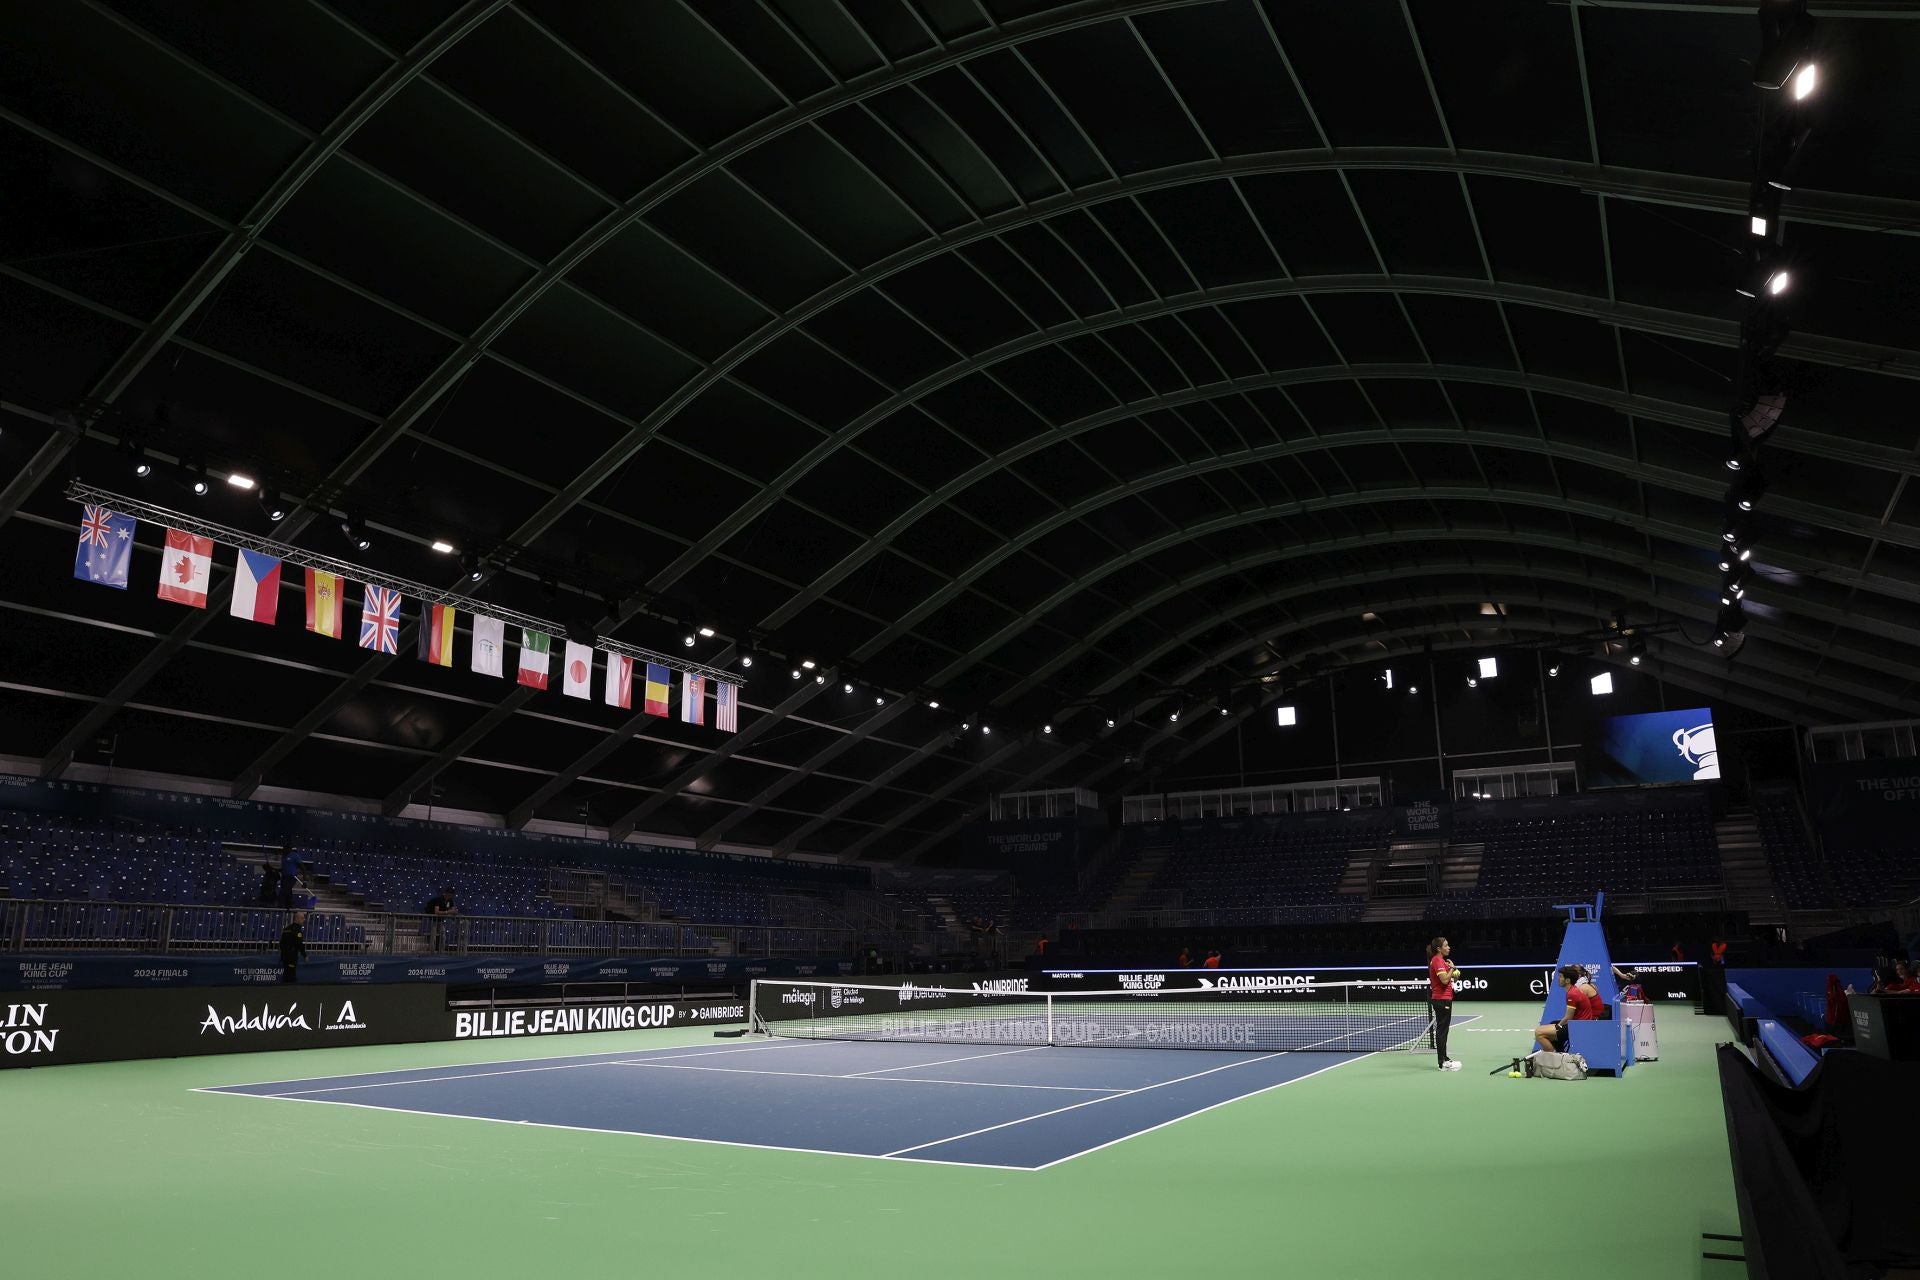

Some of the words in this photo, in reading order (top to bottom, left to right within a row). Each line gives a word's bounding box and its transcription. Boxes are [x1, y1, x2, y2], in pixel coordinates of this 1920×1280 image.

[1856, 778, 1889, 791] THE
[1883, 789, 1905, 800] OF
[1908, 788, 1920, 800] T
[1406, 807, 1439, 816] WORLD
[1408, 815, 1426, 823] CUP
[1427, 814, 1439, 822] OF
[1408, 822, 1440, 831] TENNIS
[987, 834, 1006, 844] THE
[1007, 833, 1041, 843] WORLD
[1043, 832, 1062, 842] CUP
[1000, 843, 1013, 853] OF
[1014, 842, 1048, 852] TENNIS
[20, 962, 47, 970] BILLIE
[48, 962, 73, 970] JEAN
[1634, 965, 1657, 973] SERVE
[23, 970, 47, 978] KING
[48, 970, 68, 978] CUP
[133, 969, 157, 977] 2024
[157, 969, 188, 977] FINALS
[1118, 974, 1142, 983] BILLIE
[1143, 974, 1165, 983] JEAN
[982, 979, 1029, 998] GAINBRIDGE
[1123, 981, 1143, 990] KING
[1144, 981, 1161, 990] CUP
[1217, 976, 1316, 994] GAINBRIDGE
[782, 987, 816, 1006] málaga
[1667, 991, 1687, 999] km/h
[0, 1004, 48, 1027] IN
[200, 1002, 312, 1035] Andalucía
[455, 1010, 525, 1038] BILLIE
[527, 1008, 583, 1034] JEAN
[587, 1006, 634, 1031] KING
[637, 1005, 674, 1027] CUP
[678, 1010, 687, 1018] BY
[700, 1006, 744, 1019] GAINBRIDGE
[991, 1020, 1049, 1041] KING
[1056, 1021, 1100, 1042] CUP
[1146, 1023, 1256, 1045] GAINBRIDGE
